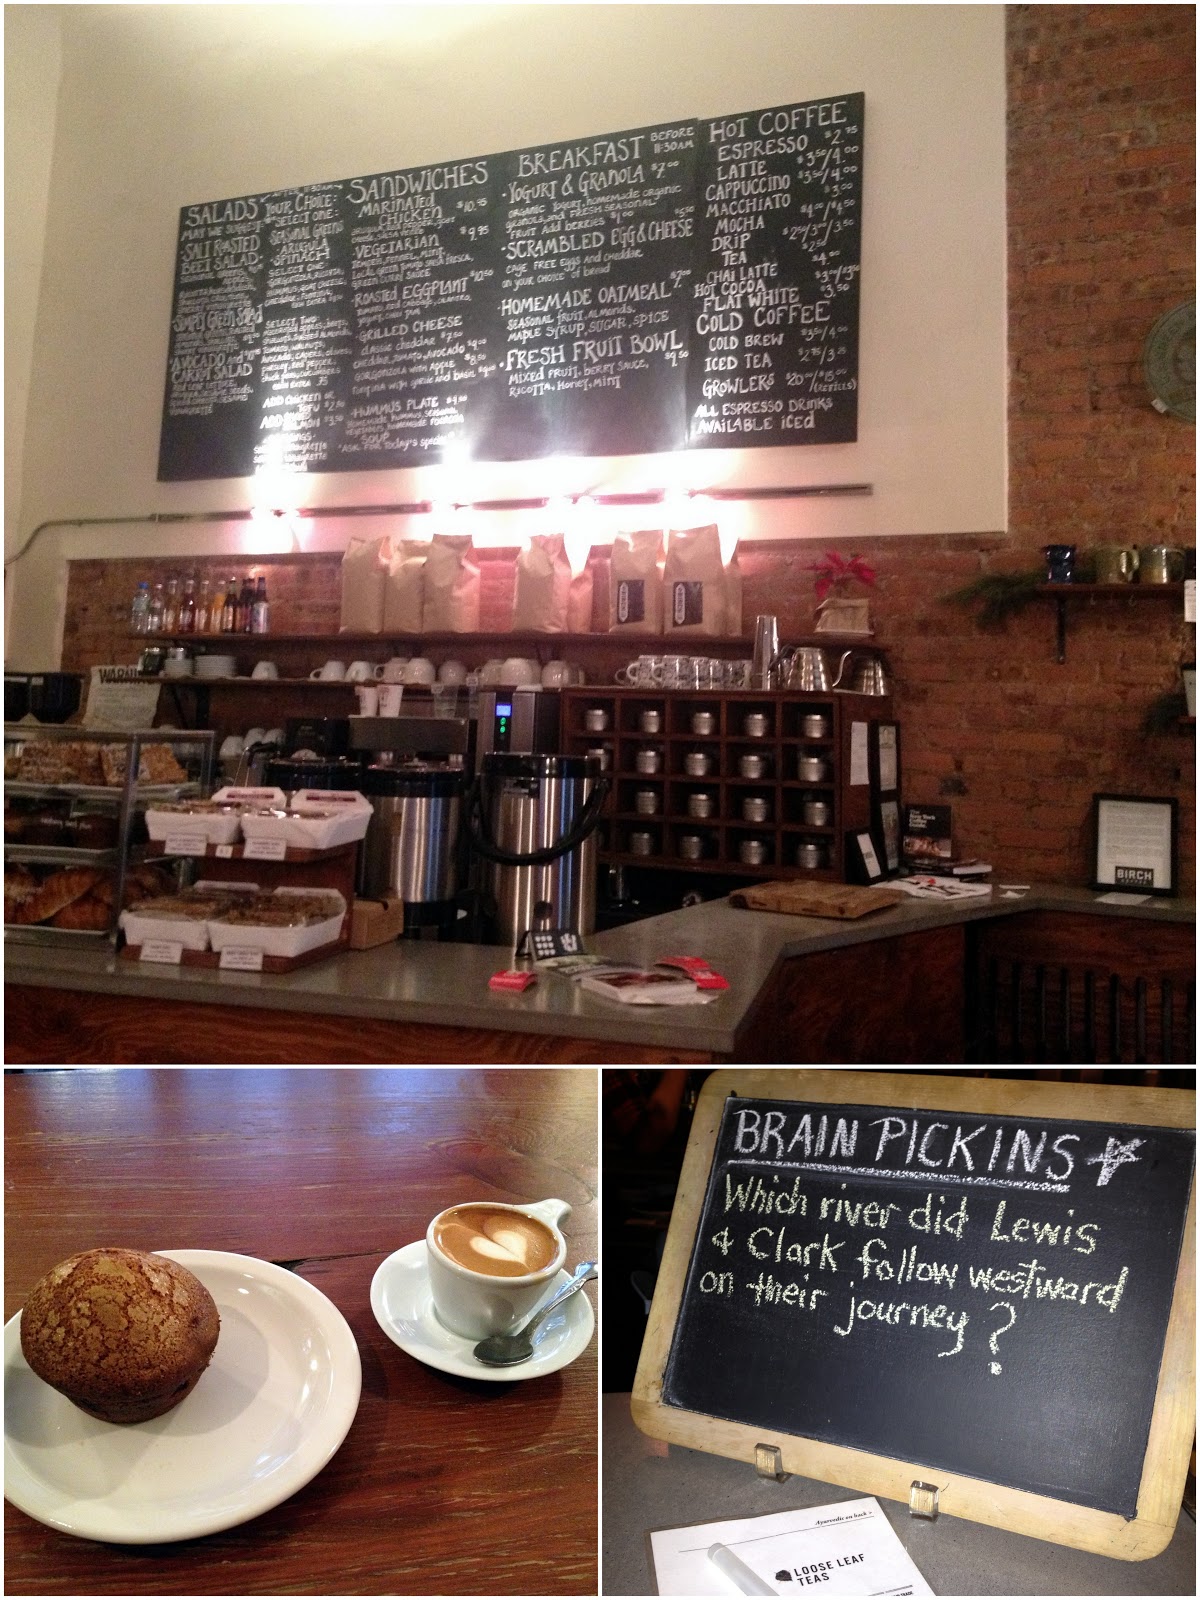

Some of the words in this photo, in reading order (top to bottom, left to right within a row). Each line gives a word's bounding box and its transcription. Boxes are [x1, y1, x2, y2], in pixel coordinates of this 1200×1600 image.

[758, 101, 848, 136] COFFEE
[650, 126, 695, 143] BEFORE
[517, 134, 646, 179] BREAKFAST
[718, 134, 809, 162] ESPRESSO
[345, 161, 489, 204] SANDWICHES
[717, 160, 769, 182] LATTE
[508, 180, 558, 204] YOGURT
[561, 173, 573, 196] &
[578, 164, 646, 197] GRANOLA
[705, 174, 791, 202] CAPPUCCINO
[185, 199, 259, 226] SALADS
[570, 206, 603, 220] FRESH
[706, 193, 792, 219] MACCHIATO
[714, 214, 766, 236] MOCHA
[505, 231, 605, 260] SCRAMBLED
[711, 232, 752, 253] DRIP
[180, 258, 212, 275] BEET
[533, 258, 557, 271] FREE
[721, 250, 748, 267] TEA
[706, 268, 736, 286] CHAI
[740, 262, 779, 281] LATTE
[501, 288, 592, 317] HOMEMADE
[597, 281, 672, 304] OATMEAL
[703, 293, 743, 314] FLAT
[747, 286, 800, 308] WHITE
[720, 279, 767, 297] COCOA
[412, 315, 463, 333] CHEESE
[696, 311, 744, 336] COLD
[753, 300, 832, 329] COFFEE
[507, 328, 542, 345] MAPLE
[708, 335, 739, 352] COLD
[744, 332, 785, 348] BREW
[505, 343, 566, 372] FRESH
[572, 334, 623, 364] FRUIT
[630, 328, 684, 356] BOWL
[704, 355, 739, 372] ICED
[743, 352, 773, 370] TEA
[702, 371, 776, 400] GROWLERS
[406, 396, 440, 411] PLATE
[694, 402, 720, 419] ALL
[722, 399, 784, 417] ESPRESSO
[696, 416, 774, 435] AVAILABLE
[1116, 869, 1153, 881] BIRCH
[734, 1108, 860, 1161] BRAIN
[869, 1115, 1081, 1183] PICKINS
[724, 1173, 808, 1217] Which
[818, 1182, 903, 1231] river
[907, 1192, 970, 1242] did
[989, 1200, 1101, 1255] Lewis
[747, 1226, 847, 1273] Clark
[856, 1236, 961, 1290] follow
[967, 1257, 1130, 1314] westward
[700, 1268, 735, 1298] on
[744, 1271, 829, 1311] their
[832, 1280, 971, 1359] journey
[987, 1300, 1018, 1377] ?
[814, 1515, 846, 1527] Ayurvedic
[854, 1510, 868, 1520] back
[793, 1559, 835, 1578] LOOSE
[836, 1552, 866, 1568] LEAF
[796, 1571, 831, 1587] TEAS
